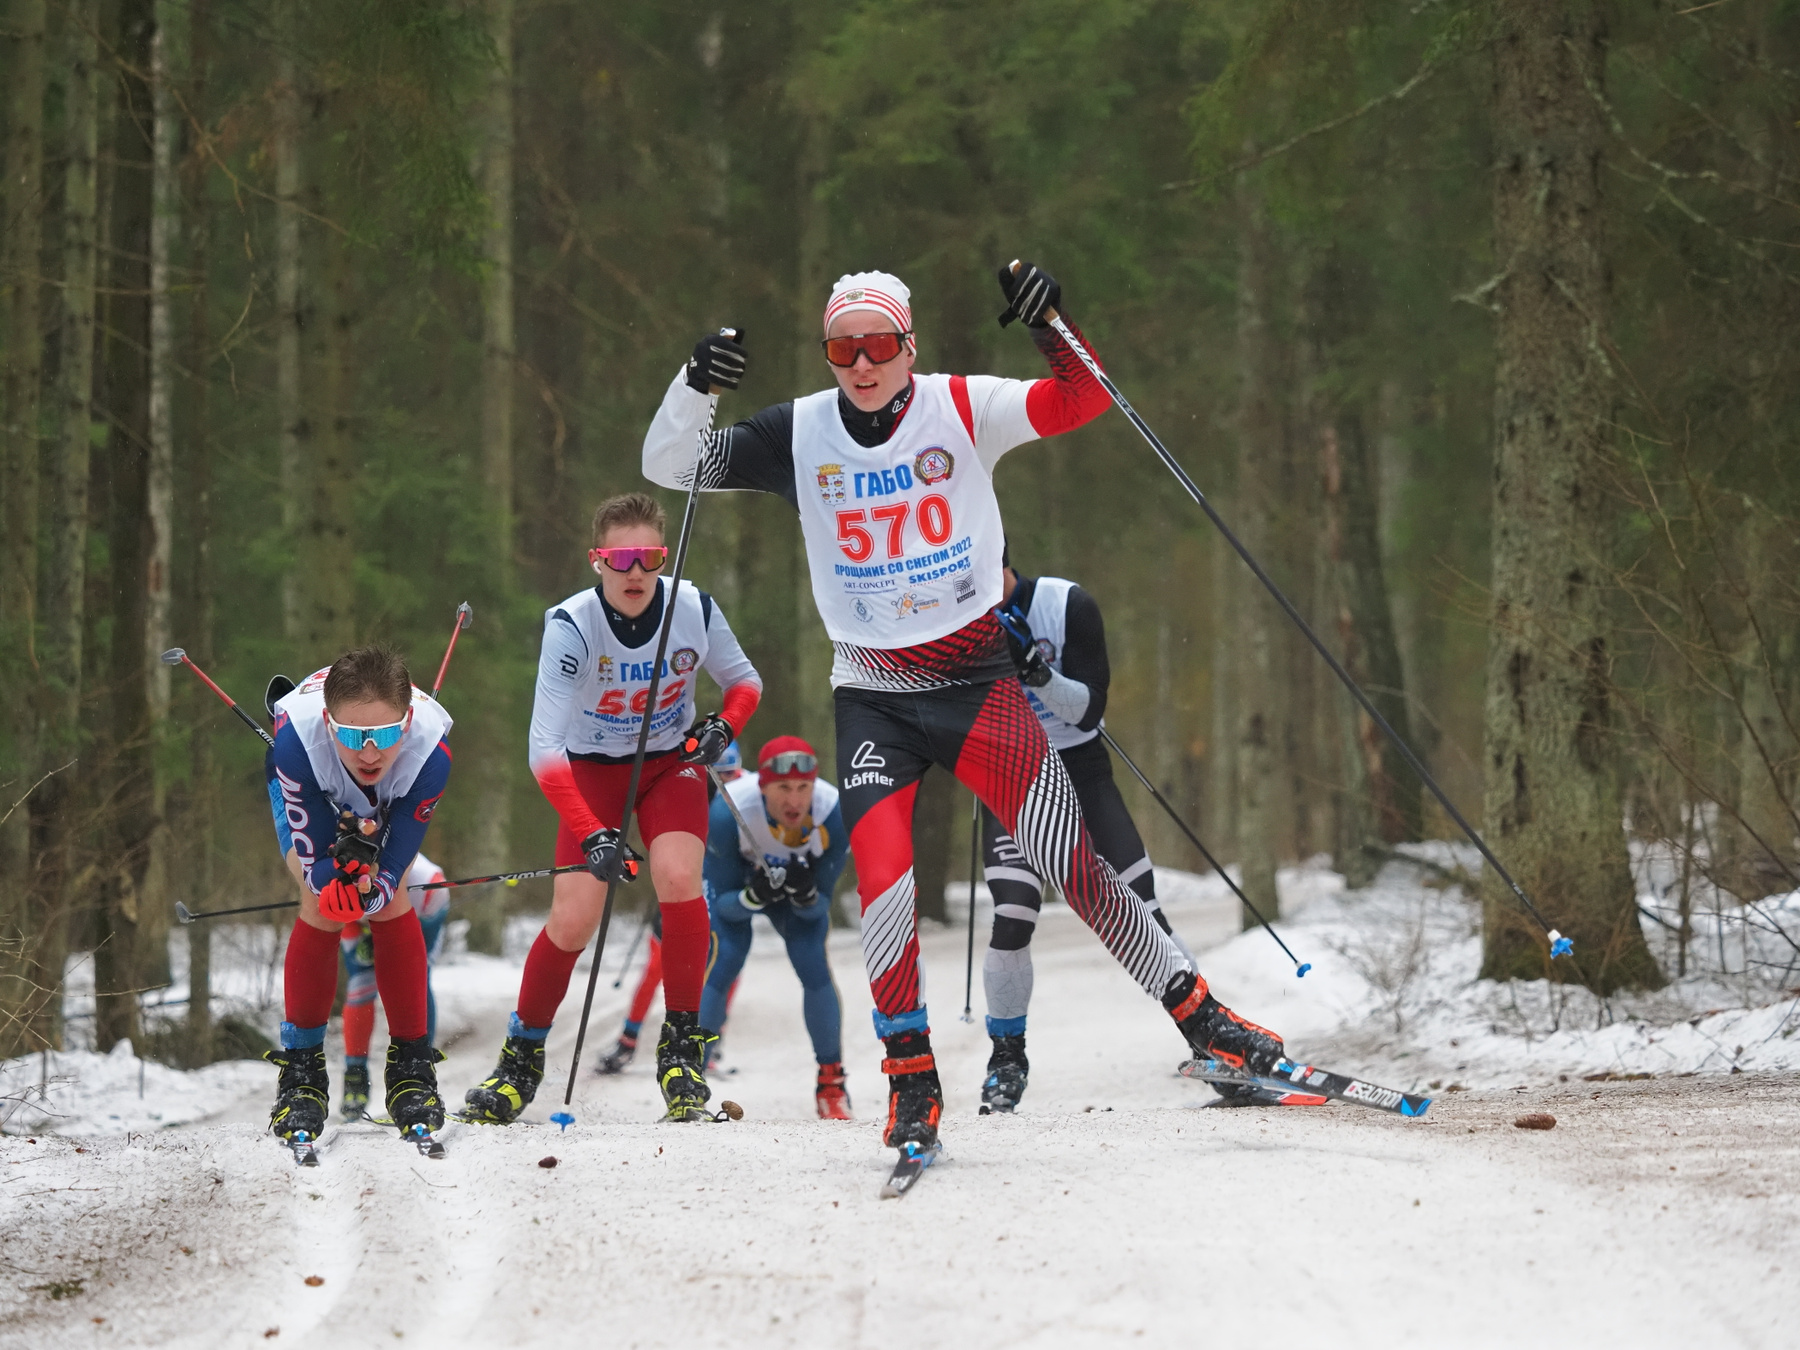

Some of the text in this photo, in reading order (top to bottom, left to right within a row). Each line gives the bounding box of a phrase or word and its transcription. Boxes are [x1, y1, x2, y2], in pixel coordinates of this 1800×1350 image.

[854, 464, 913, 499] ГАБО
[835, 493, 953, 564] 570
[835, 536, 973, 579] ПРОЩАНИЕ СО СНЕГОМ 2022
[908, 555, 970, 584] SKISPORT
[843, 579, 896, 589] ART-CONCEPT
[649, 703, 686, 731] KISPORT
[843, 771, 895, 790] Löffler
